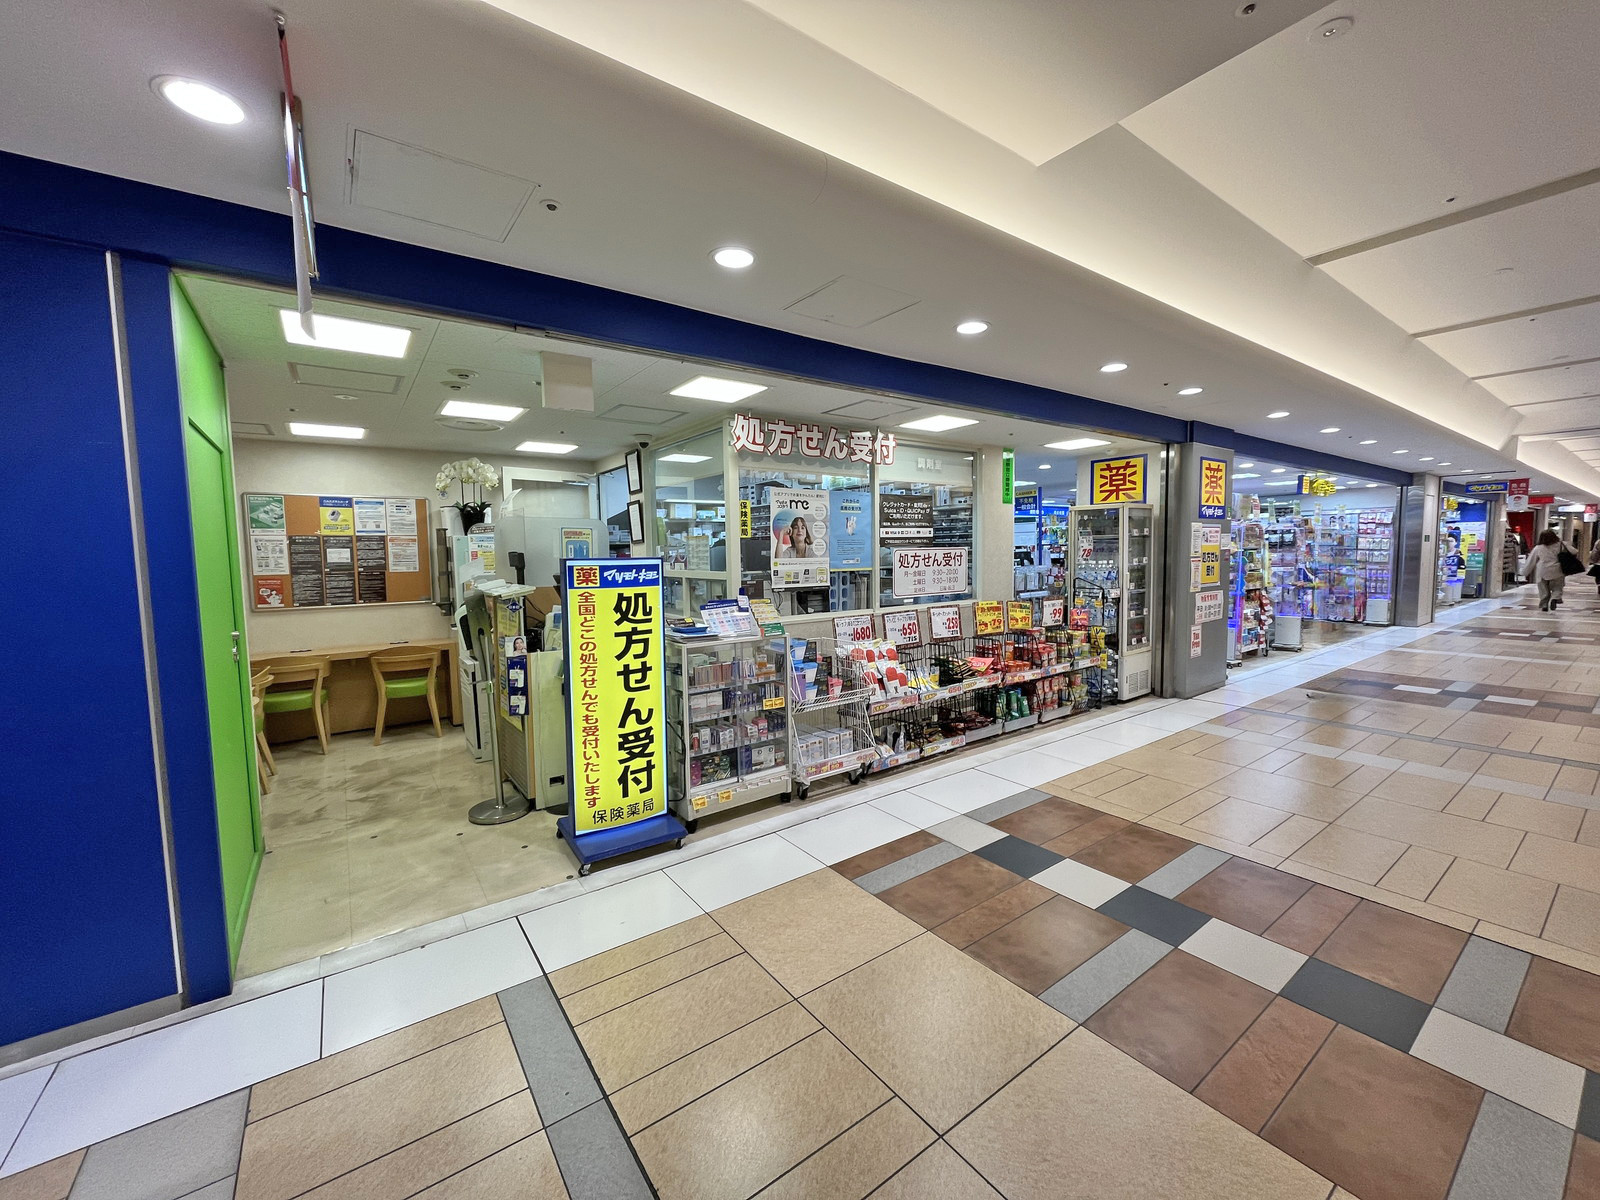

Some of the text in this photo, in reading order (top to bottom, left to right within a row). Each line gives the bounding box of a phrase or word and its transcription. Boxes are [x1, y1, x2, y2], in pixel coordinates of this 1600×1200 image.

[731, 413, 897, 466] 処方せん受付
[1099, 461, 1138, 502] 薬
[1204, 462, 1223, 504] 薬
[740, 501, 748, 537] 保険薬局
[789, 499, 810, 510] me
[575, 566, 599, 586] 薬
[603, 568, 659, 584] マツモトキヨシ
[898, 551, 964, 569] 処方せん受付
[902, 621, 917, 637] 650
[577, 591, 601, 809] 全国どこの処方せんでも受付いたします
[612, 592, 655, 799] 処方せん受付
[592, 797, 655, 825] 保険薬局
